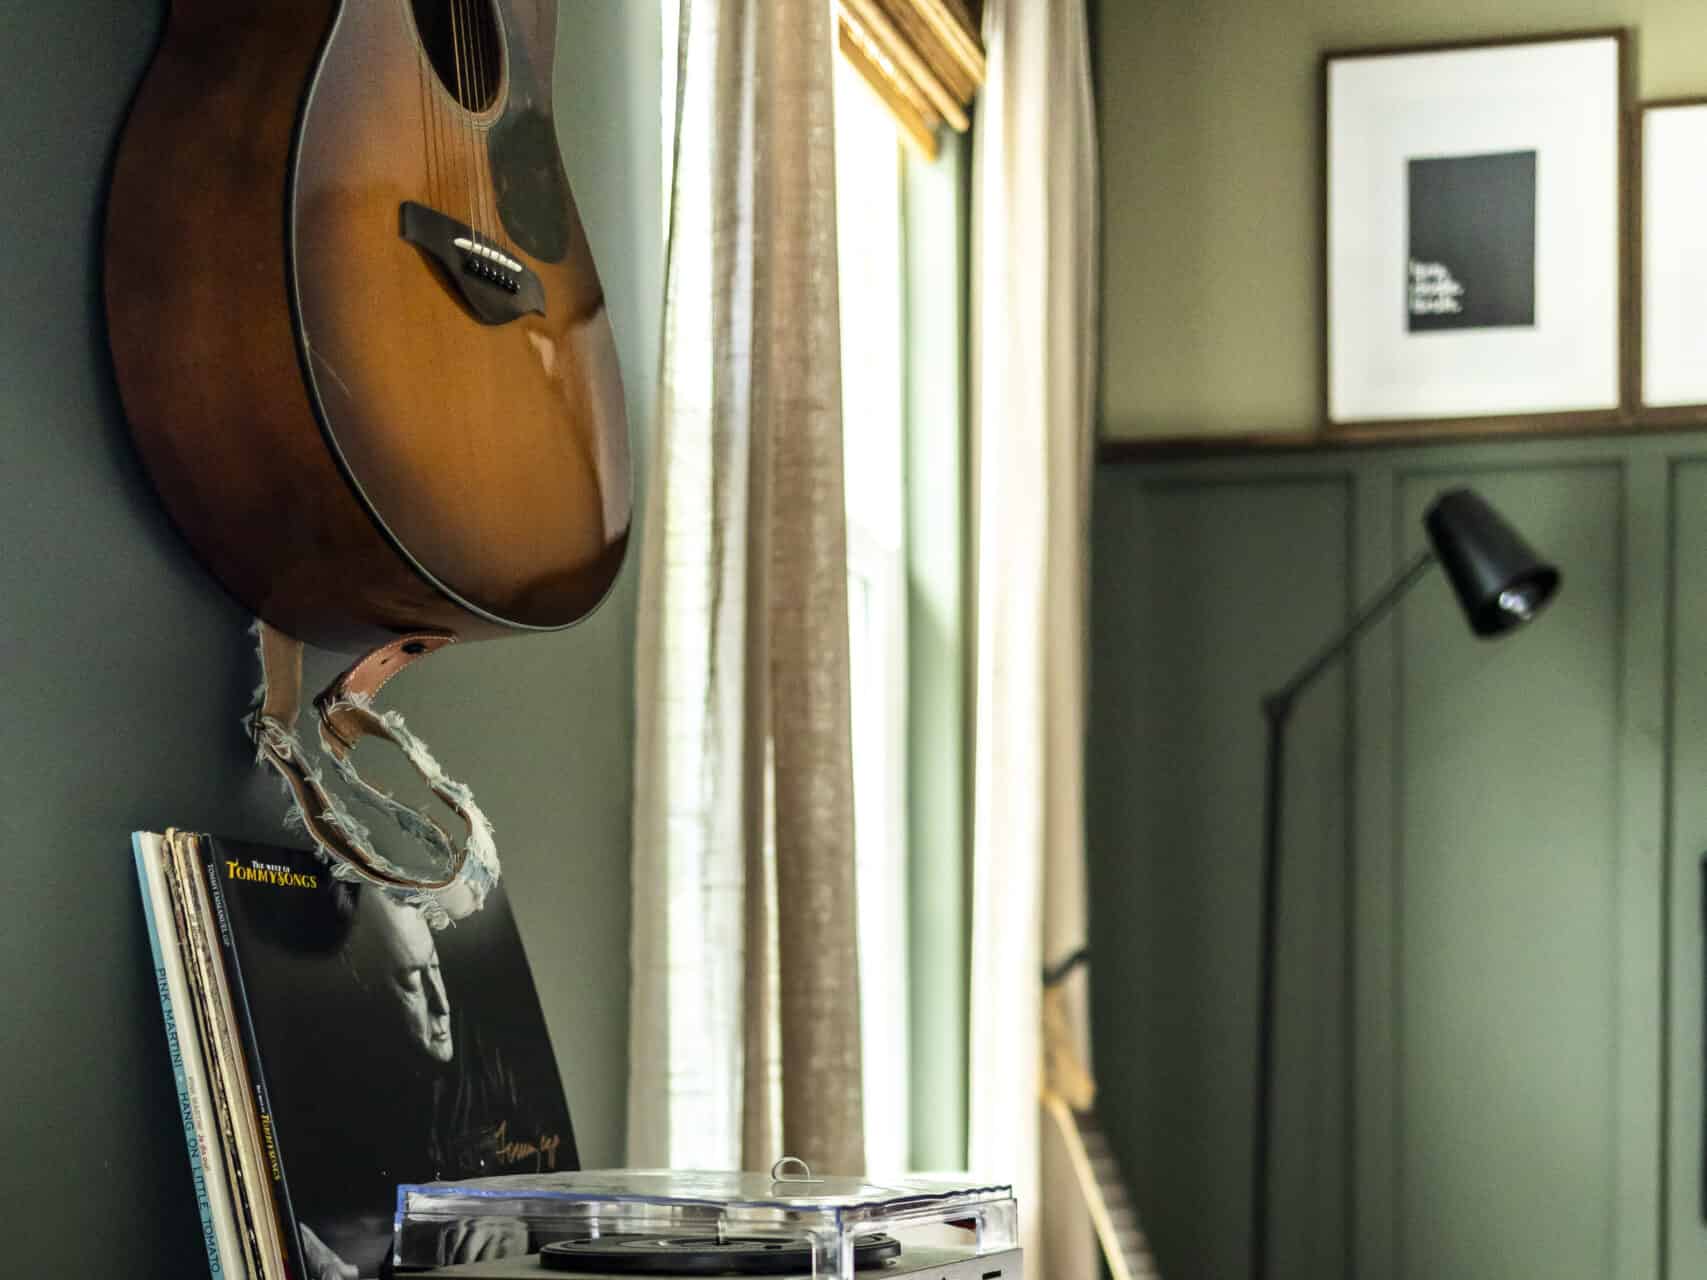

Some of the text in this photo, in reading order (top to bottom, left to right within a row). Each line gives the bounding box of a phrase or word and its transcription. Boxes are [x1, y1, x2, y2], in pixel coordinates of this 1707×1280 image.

[225, 858, 318, 889] TOMMYSONGS
[157, 967, 170, 1002] PINK
[165, 1009, 183, 1067] MARTINI
[179, 1093, 194, 1131] HANG
[188, 1138, 200, 1158] ON
[192, 1166, 209, 1210] LITTLE
[202, 1217, 220, 1273] TOMATO
